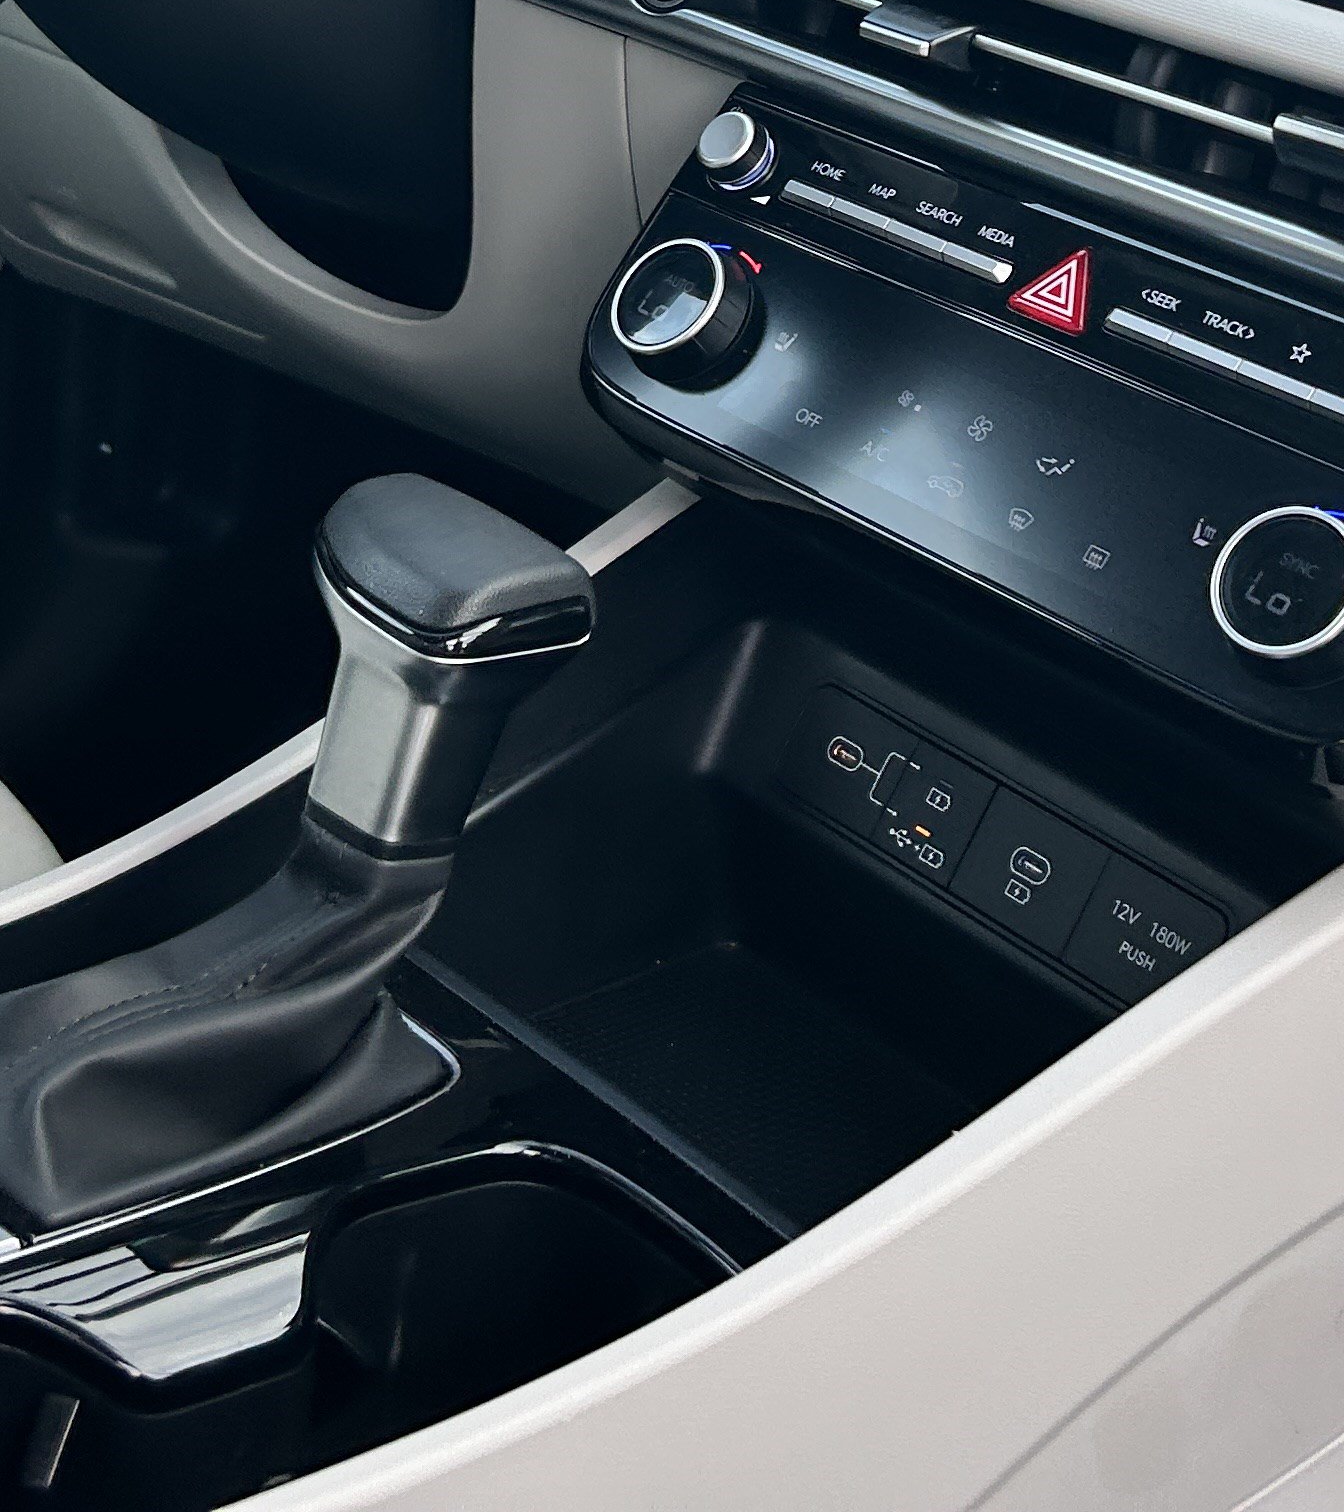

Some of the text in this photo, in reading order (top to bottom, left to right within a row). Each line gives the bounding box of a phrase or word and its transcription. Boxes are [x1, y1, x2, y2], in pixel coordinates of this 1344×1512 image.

[811, 160, 847, 182] HOME
[868, 183, 897, 200] MAP
[915, 200, 963, 227] SEARCH
[977, 225, 1016, 248] MEDIA
[795, 408, 823, 428] OFF
[1112, 899, 1192, 956] 12V 180W
[1118, 940, 1157, 972] PUSH
